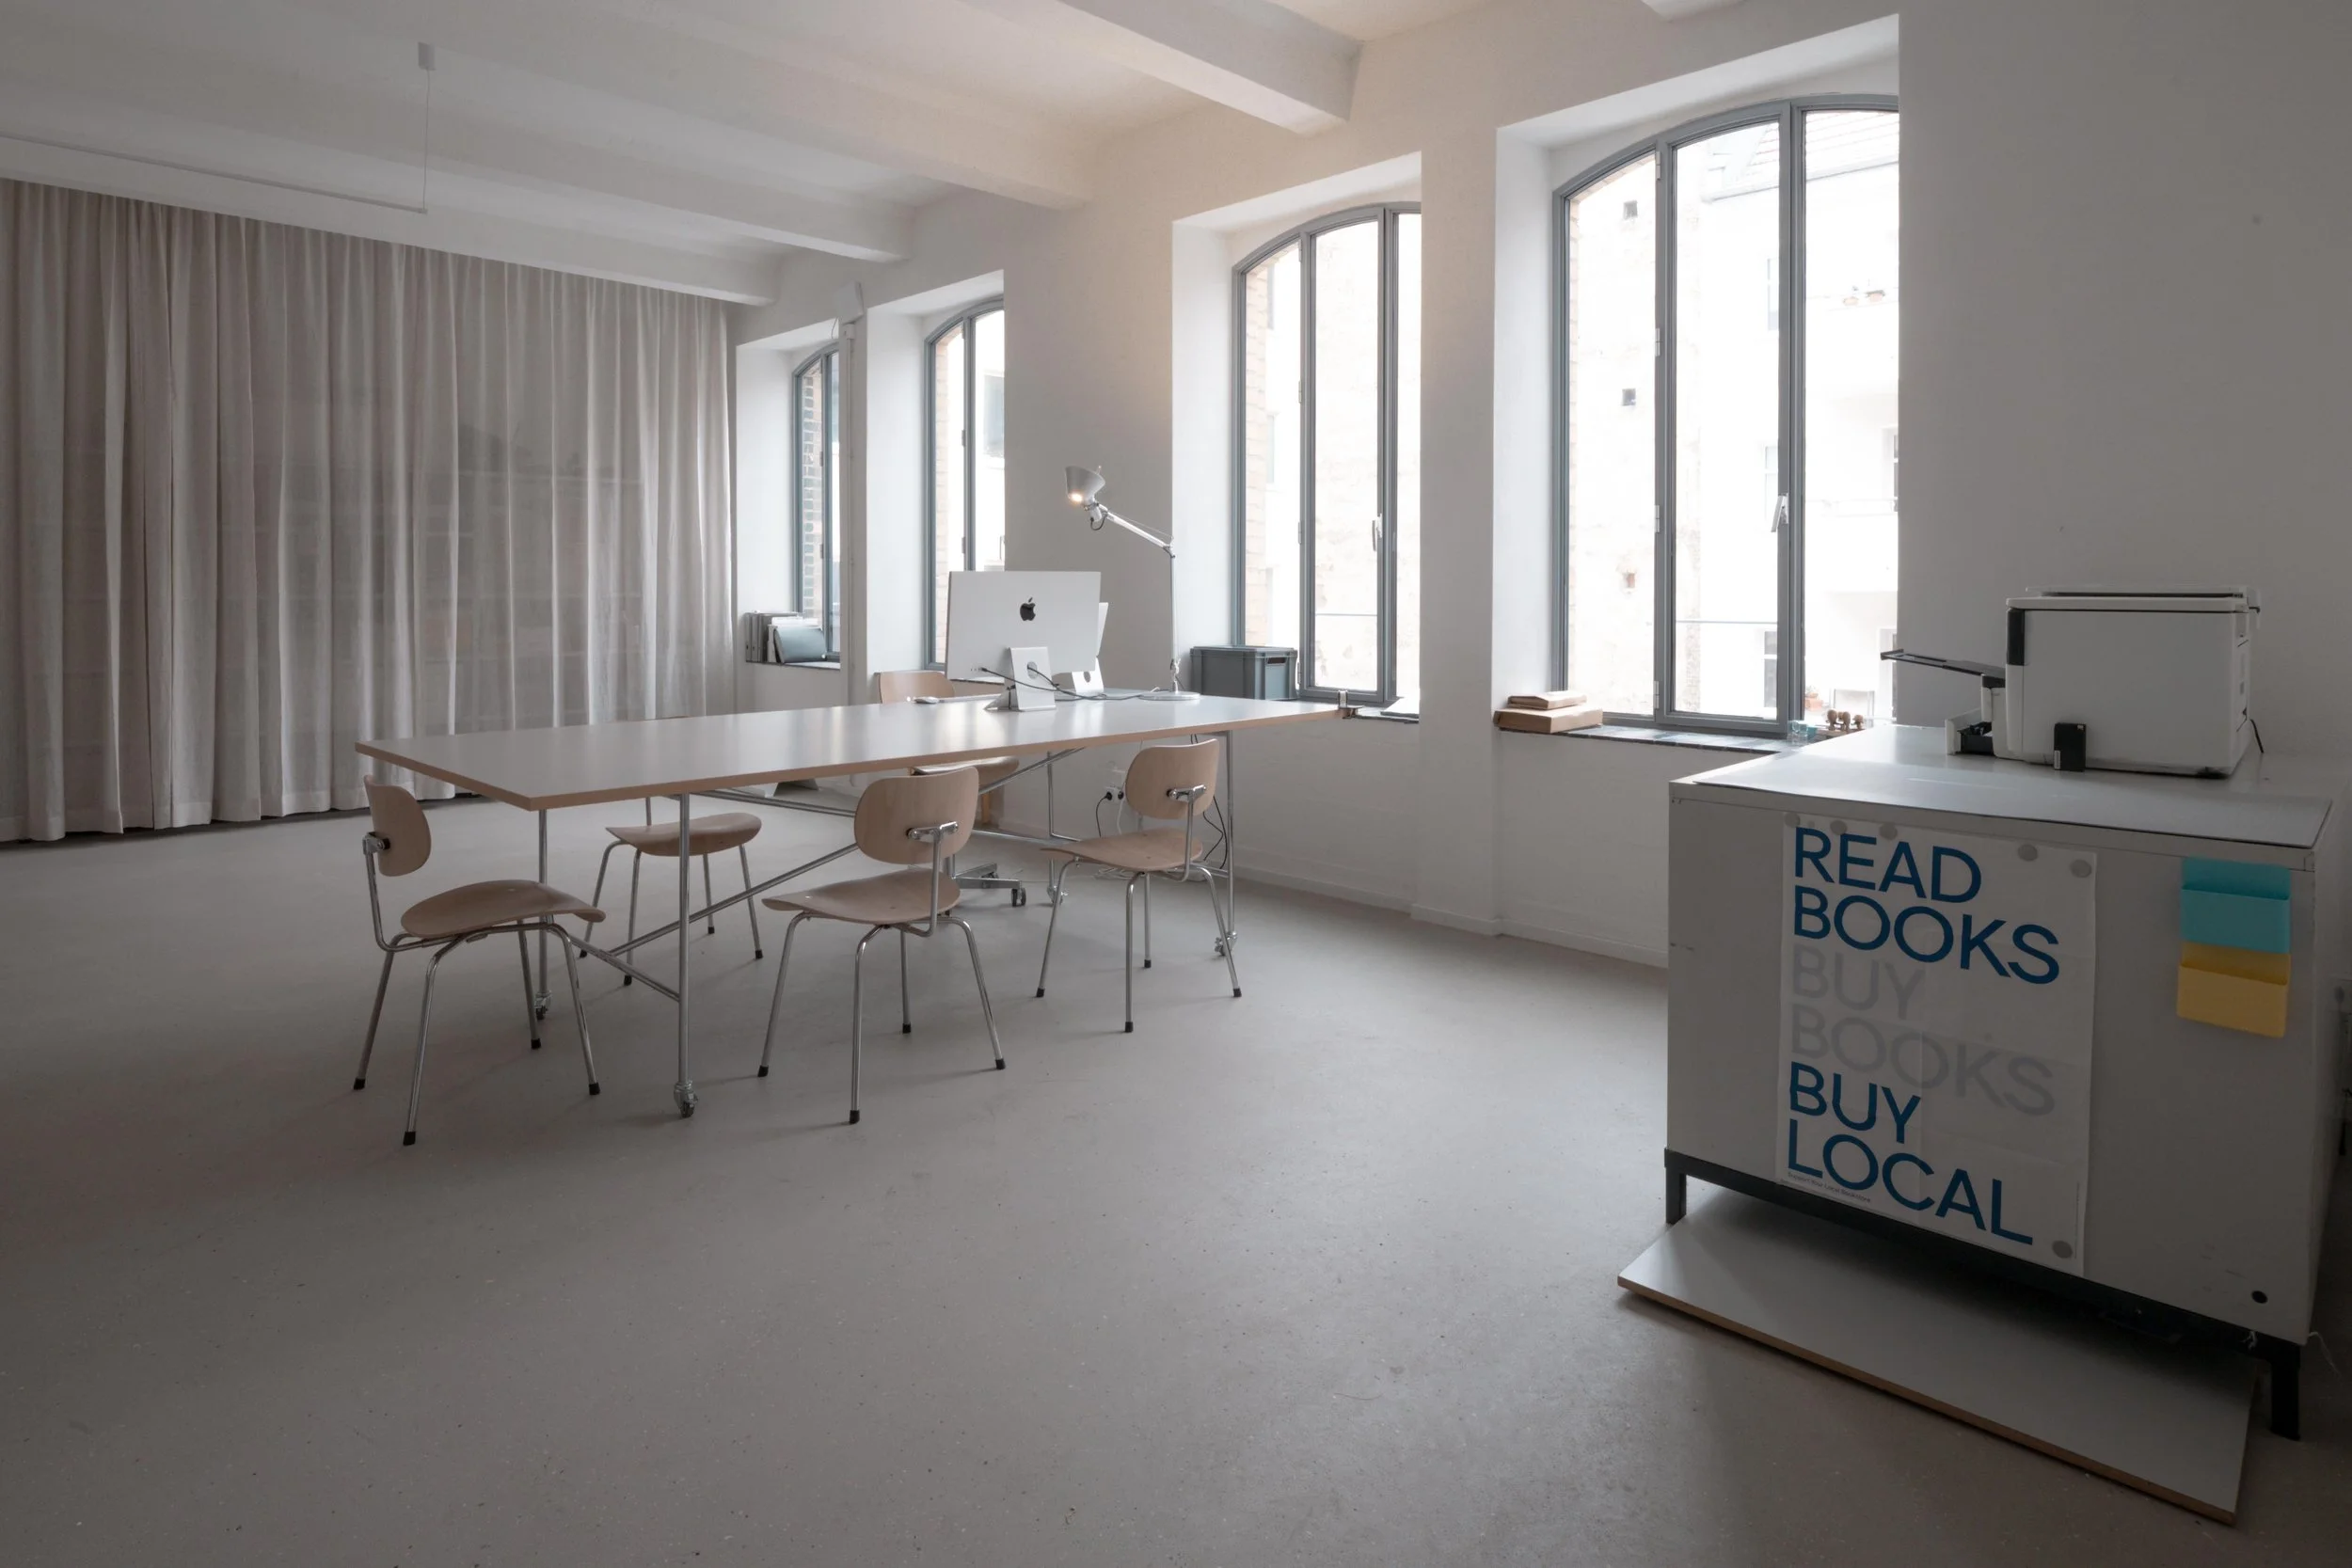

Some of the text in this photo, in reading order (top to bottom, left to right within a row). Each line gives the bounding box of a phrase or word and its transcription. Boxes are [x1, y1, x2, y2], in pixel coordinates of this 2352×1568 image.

[1795, 827, 1982, 904] READ
[1794, 886, 2060, 985] BOOKS
[1793, 946, 1925, 1021] BUY
[1789, 1061, 1921, 1145] BUY
[1791, 1006, 2055, 1117] BOOKS
[1788, 1119, 2033, 1245] LOCAL
